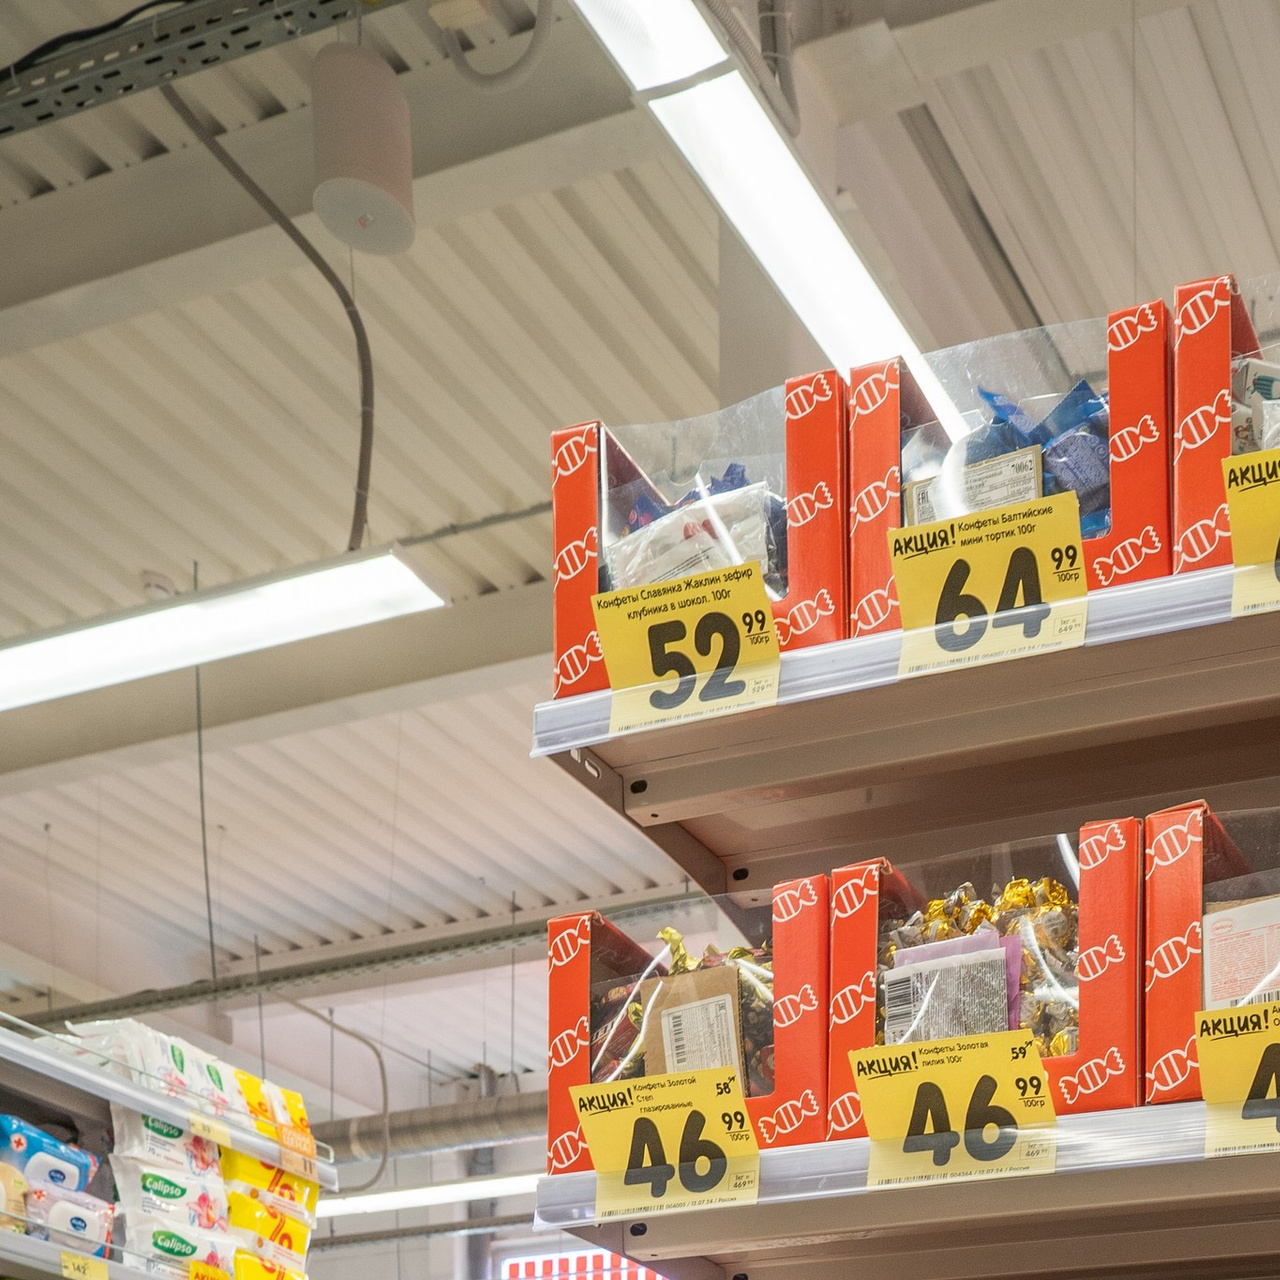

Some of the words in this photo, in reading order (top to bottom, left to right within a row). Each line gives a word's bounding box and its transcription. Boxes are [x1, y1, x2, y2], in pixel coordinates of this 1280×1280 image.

[958, 517, 999, 532] Конфеты
[1002, 506, 1052, 523] Балтийские
[893, 523, 956, 556] АКЦИЯ!
[597, 595, 639, 610] Конфеты
[641, 584, 682, 600] Славянка
[684, 577, 721, 590] Жаклин
[723, 568, 752, 583] зефир
[935, 547, 1051, 652] 64
[1051, 545, 1077, 570] 99
[648, 612, 746, 710] 52
[158, 1235, 191, 1255] Calipso
